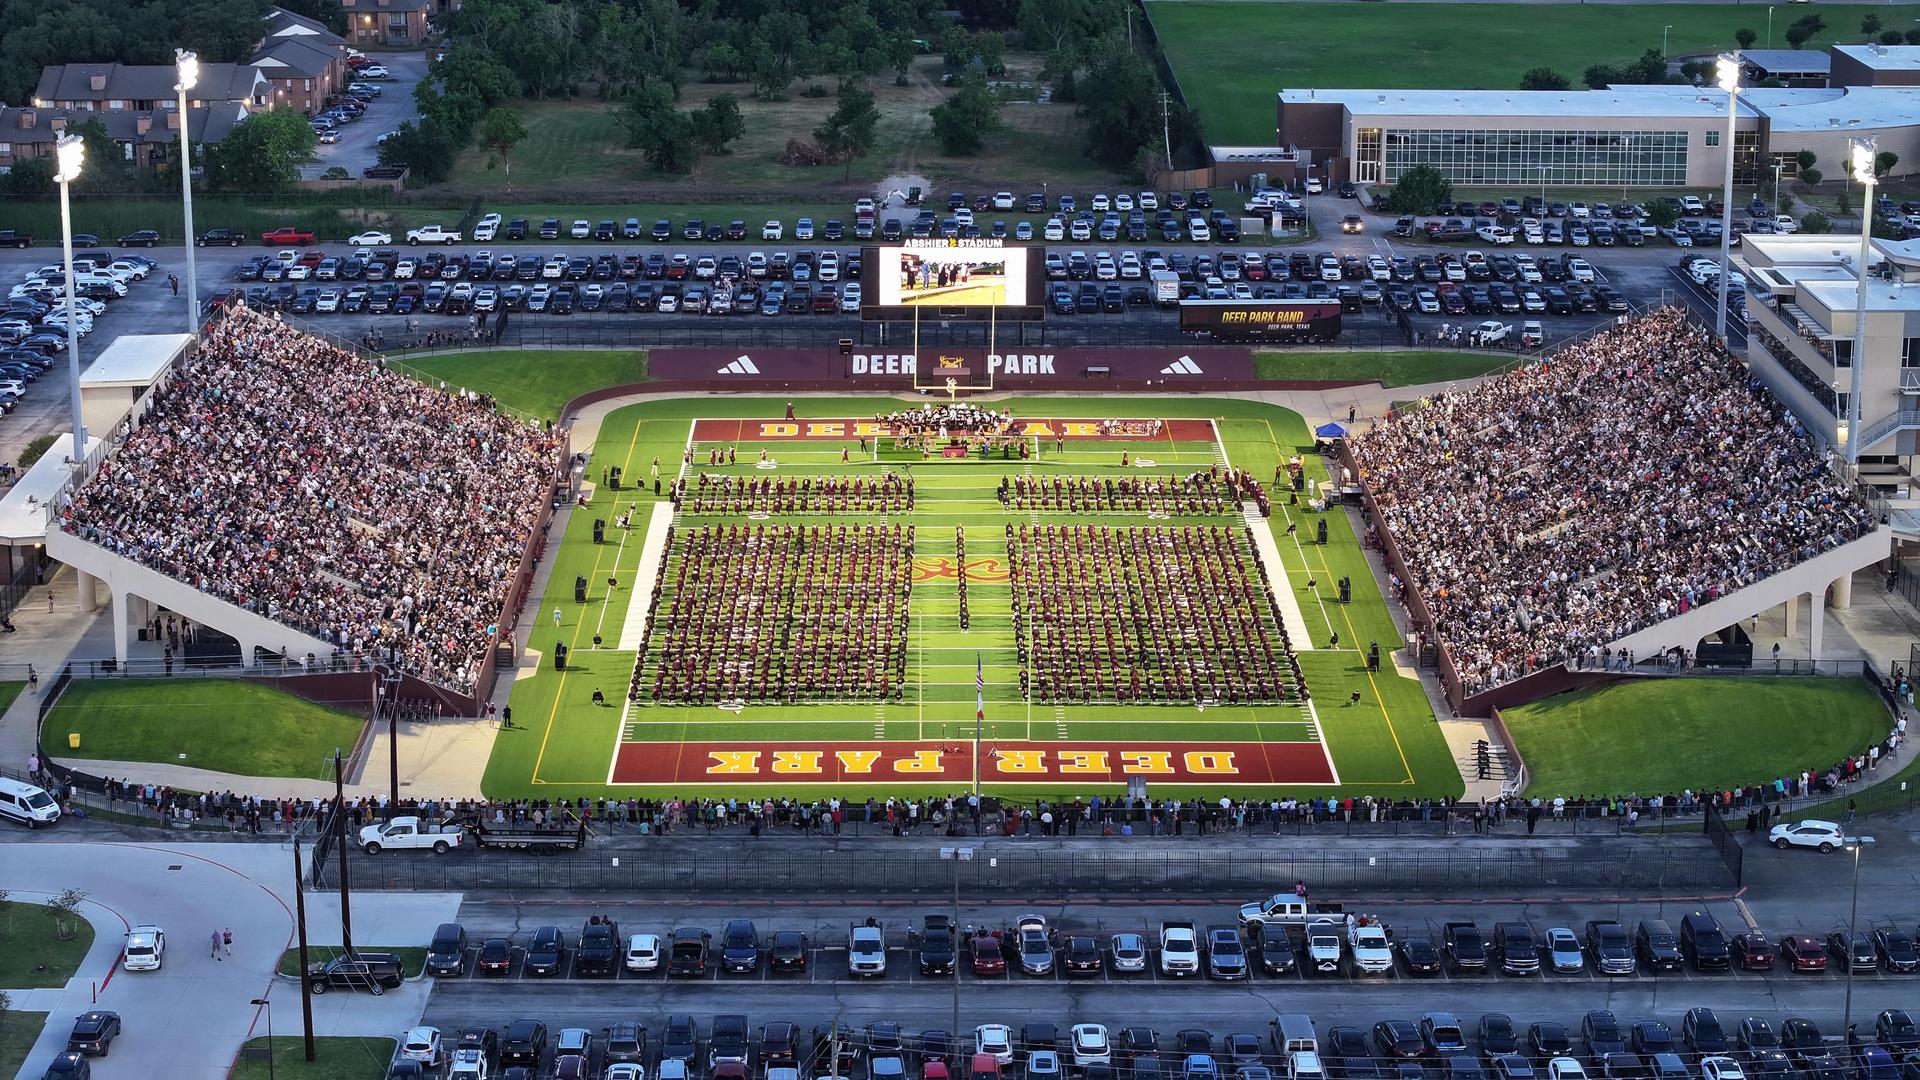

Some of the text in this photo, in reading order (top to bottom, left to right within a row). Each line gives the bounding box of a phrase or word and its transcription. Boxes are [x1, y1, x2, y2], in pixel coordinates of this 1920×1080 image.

[904, 239, 1003, 248] ABSHIER STADIUM
[1222, 311, 1304, 324] DEER PARK BAND
[852, 354, 1056, 374] DEER PARK
[706, 751, 1240, 774] DEER PARK
